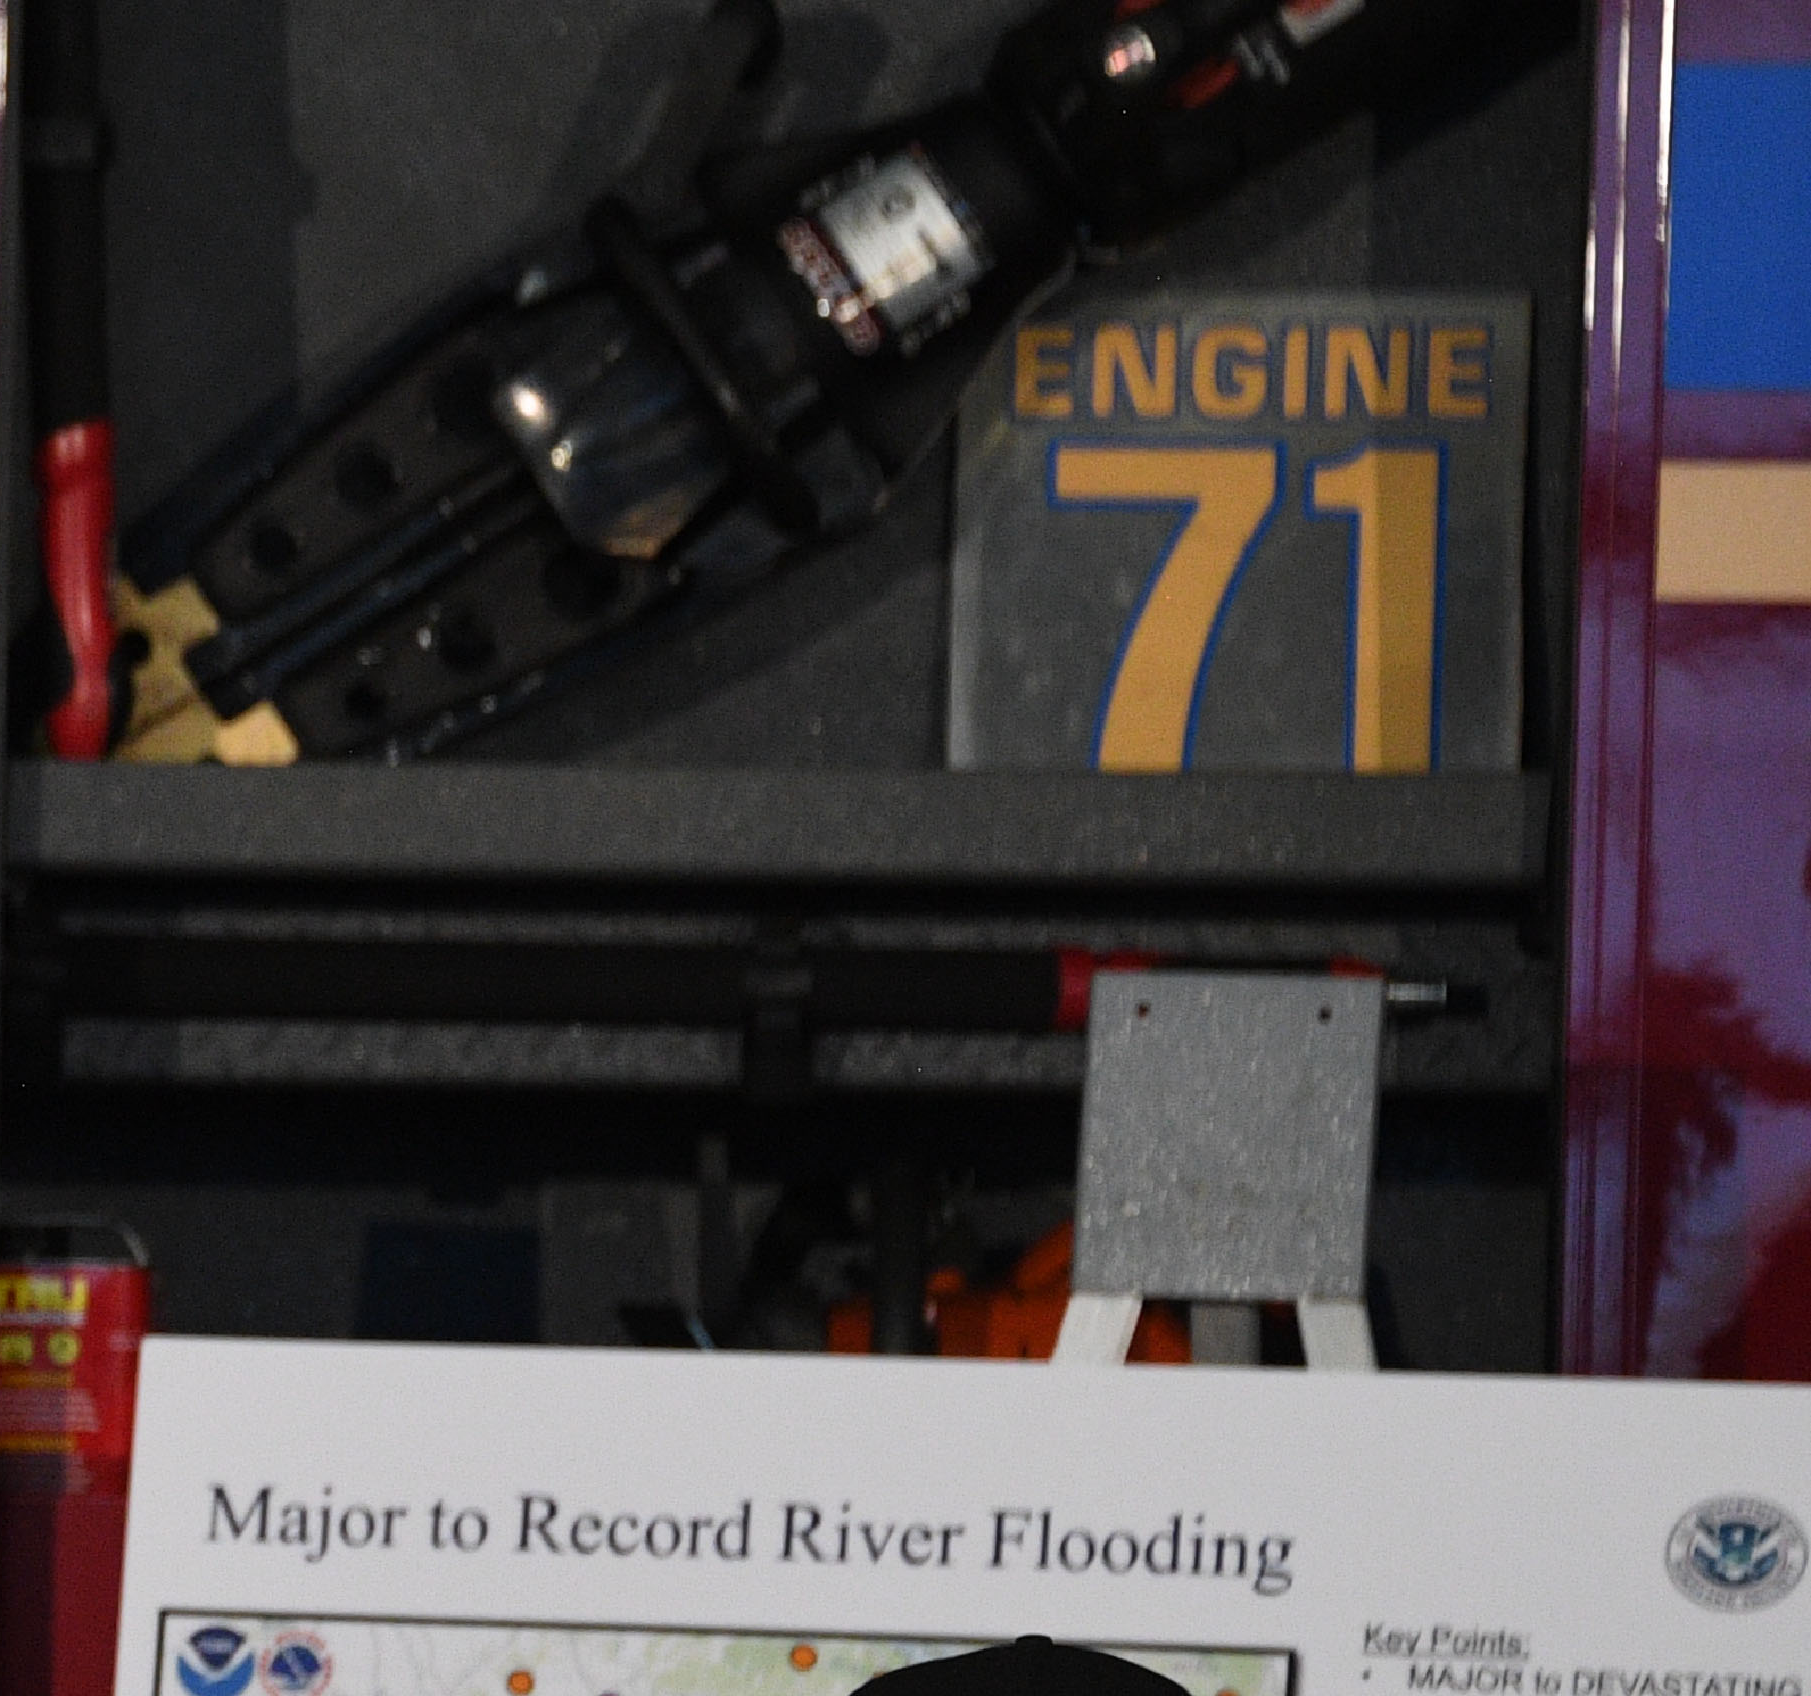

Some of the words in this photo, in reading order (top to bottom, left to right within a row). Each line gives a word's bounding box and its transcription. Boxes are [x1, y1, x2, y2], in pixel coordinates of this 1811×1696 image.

[1013, 320, 1490, 421] ENGINE
[1048, 436, 1448, 775] 71
[205, 1484, 407, 1562] Major
[430, 1500, 490, 1550] to
[517, 1494, 753, 1562] Record
[779, 1500, 965, 1567] River
[989, 1507, 1295, 1597] Flooding
[1363, 1620, 1421, 1657] Key
[1407, 1664, 1524, 1696] MAJOR
[1535, 1669, 1562, 1696] to
